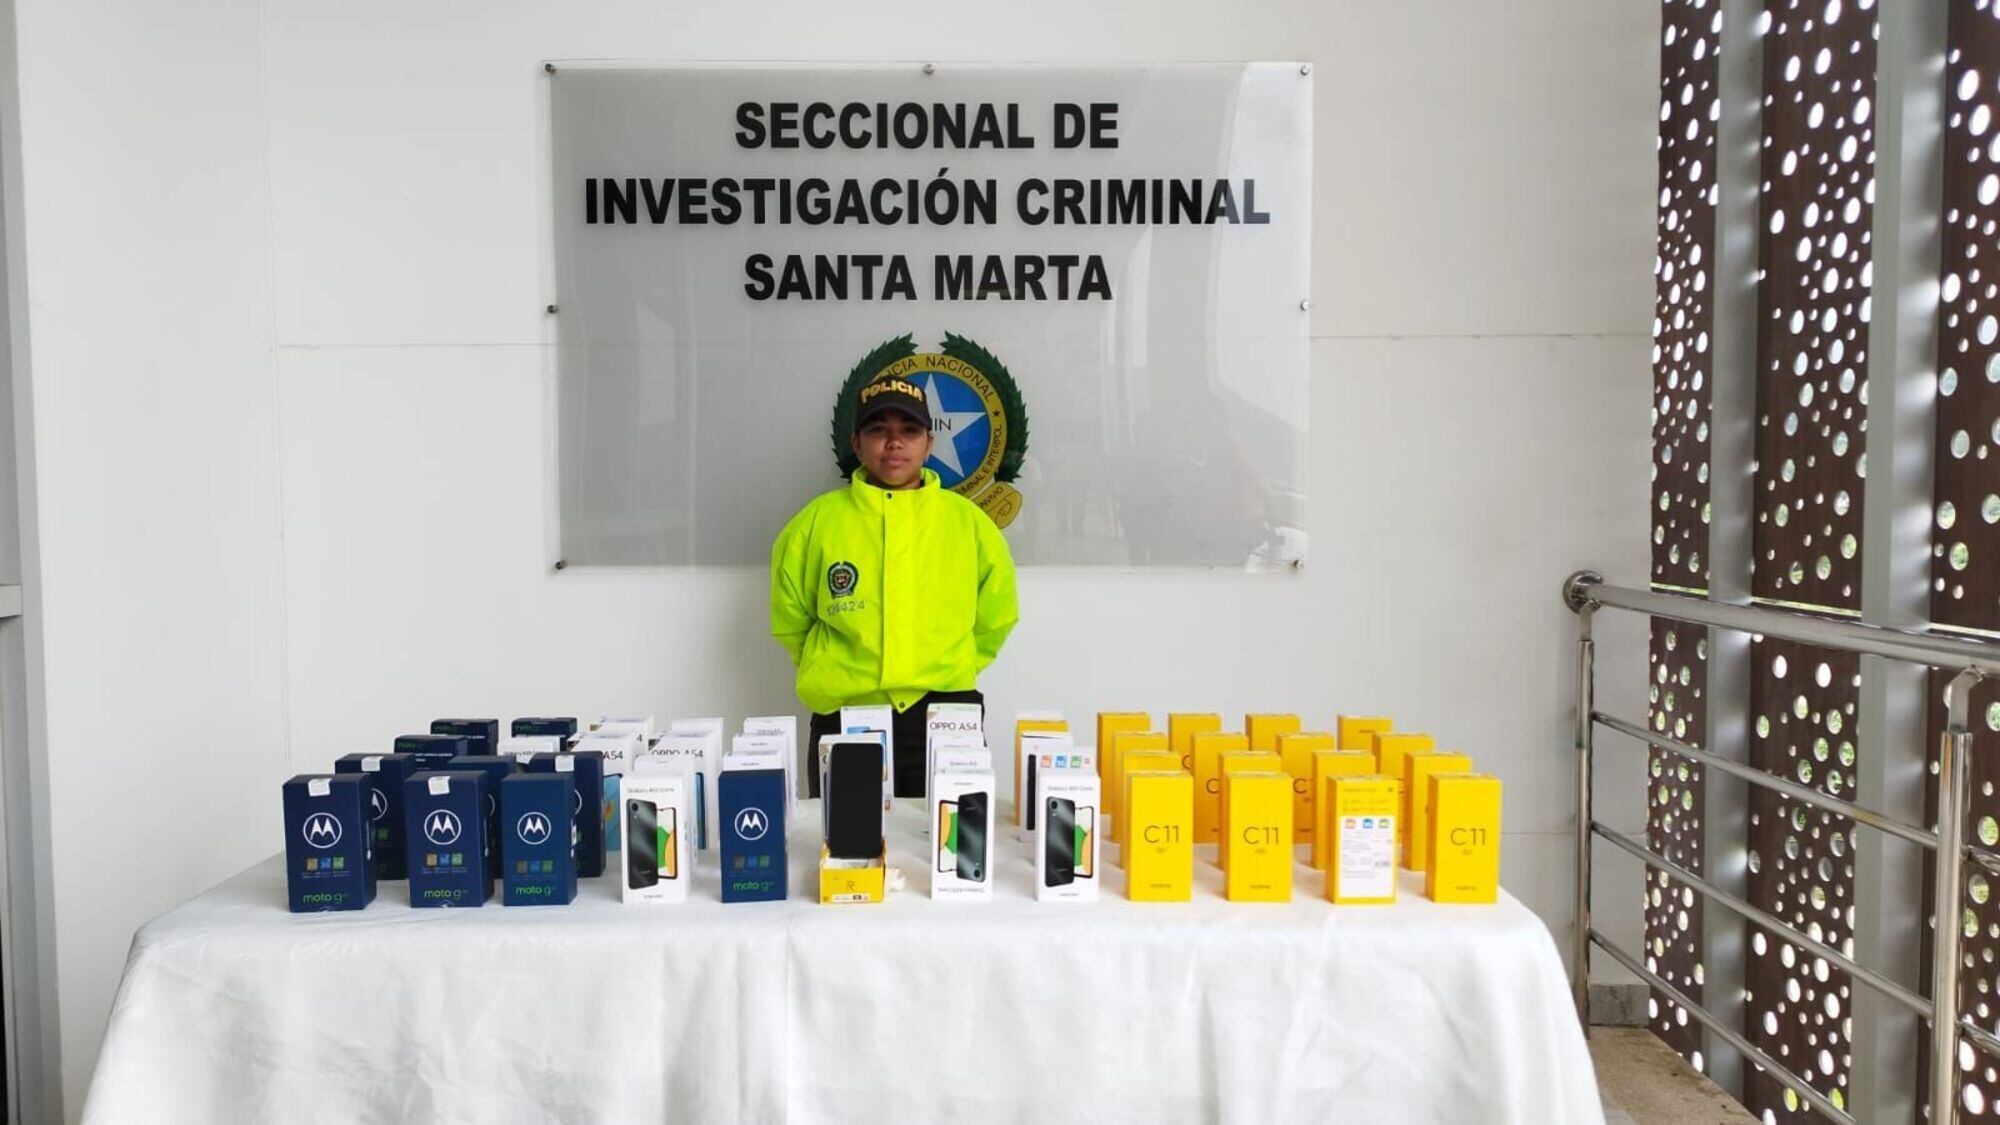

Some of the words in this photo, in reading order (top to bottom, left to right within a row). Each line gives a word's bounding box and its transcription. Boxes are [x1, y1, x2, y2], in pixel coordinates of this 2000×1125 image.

[736, 102, 1034, 149] SECCIONAL
[1054, 104, 1118, 148] DE
[586, 168, 996, 225] INVESTIGACIÓN
[1017, 178, 1269, 225] CRIMINAL
[745, 254, 916, 300] SANTA
[935, 255, 1111, 300] MARTA
[887, 358, 917, 376] ICIA
[925, 356, 994, 402] NACIONAL
[861, 380, 923, 404] POLICIA
[930, 722, 956, 731] OPPO
[959, 722, 977, 731] A54
[1144, 825, 1180, 844] C11
[1243, 826, 1280, 845] C11
[1450, 827, 1486, 846] C11
[424, 889, 451, 899] moto
[516, 885, 542, 895] moto
[733, 880, 760, 891] moto
[303, 893, 332, 903] moto
